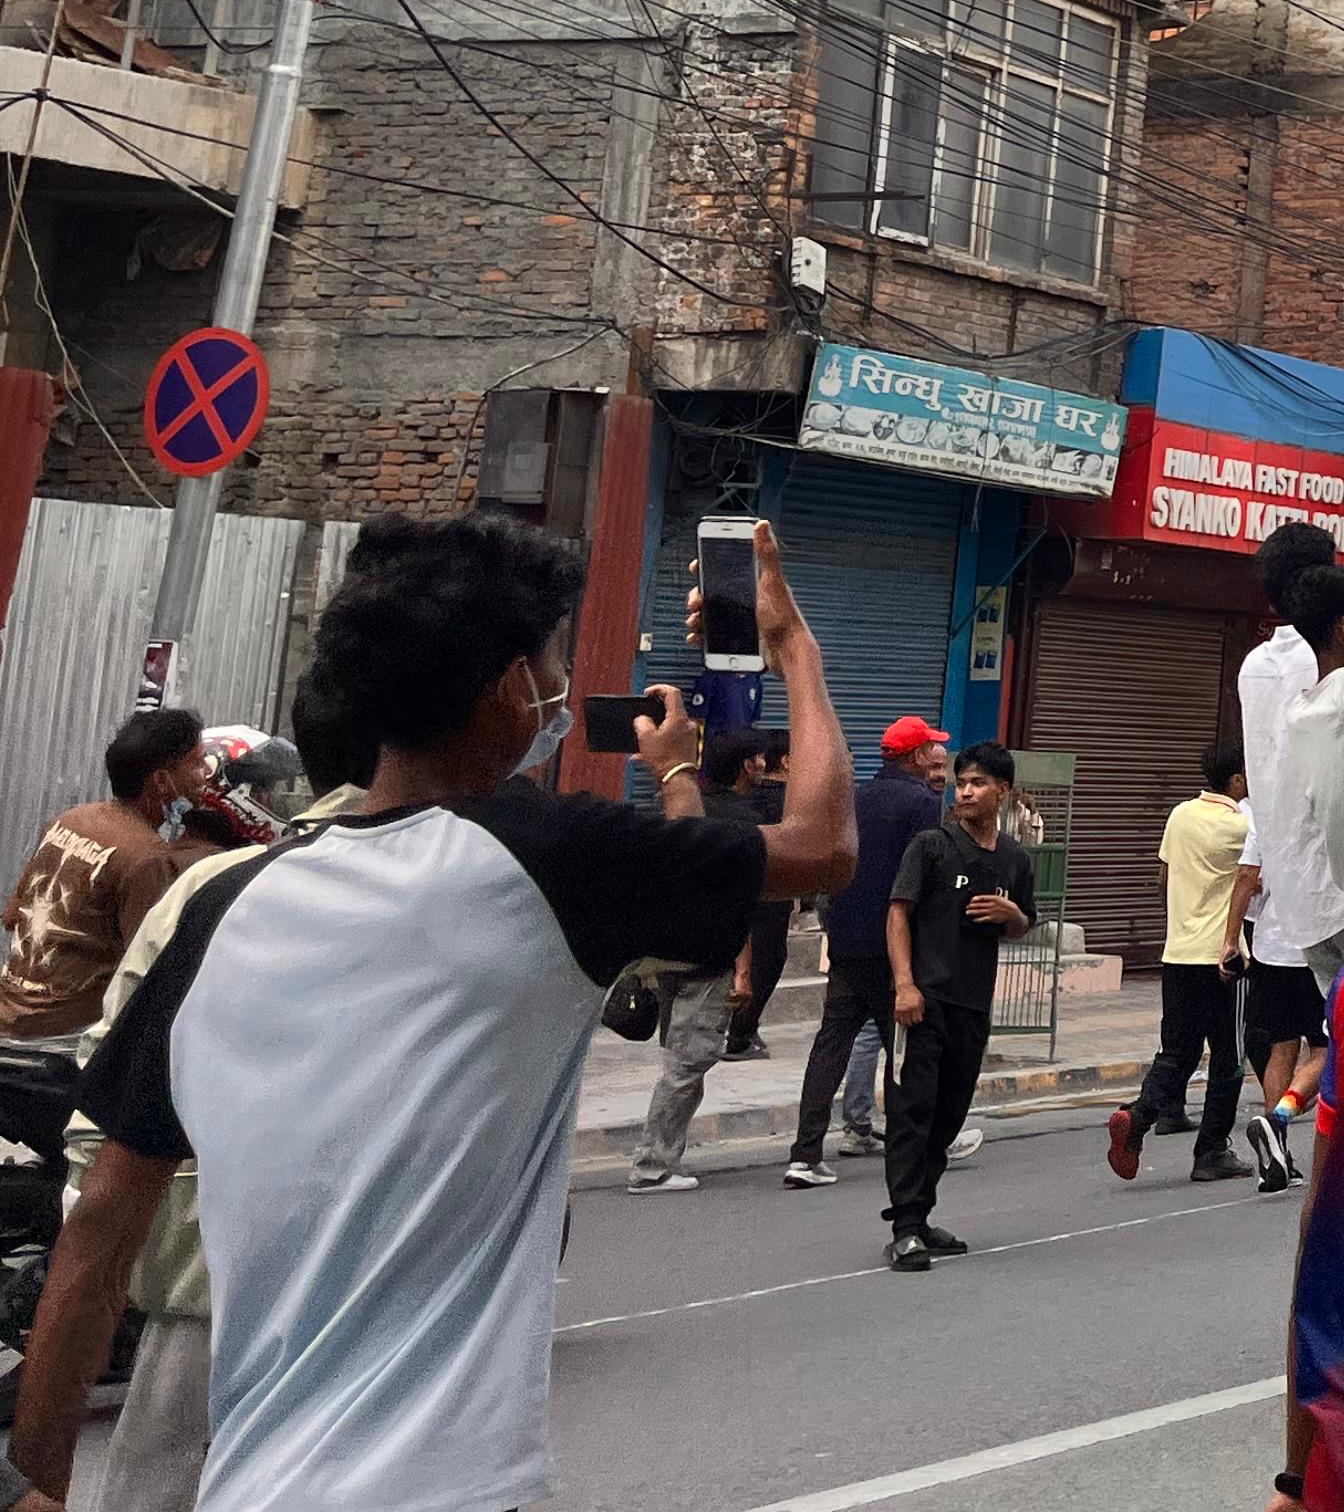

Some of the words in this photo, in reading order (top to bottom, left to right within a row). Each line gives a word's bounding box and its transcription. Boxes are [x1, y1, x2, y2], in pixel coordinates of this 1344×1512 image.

[849, 354, 945, 412] सिन्धु
[957, 382, 1047, 424] खाजा
[1055, 402, 1104, 437] घर
[1163, 447, 1253, 491] HIMALAYA
[1255, 463, 1299, 498] FAST
[1299, 471, 1344, 505] FOOD
[1151, 486, 1242, 538] SYANKO
